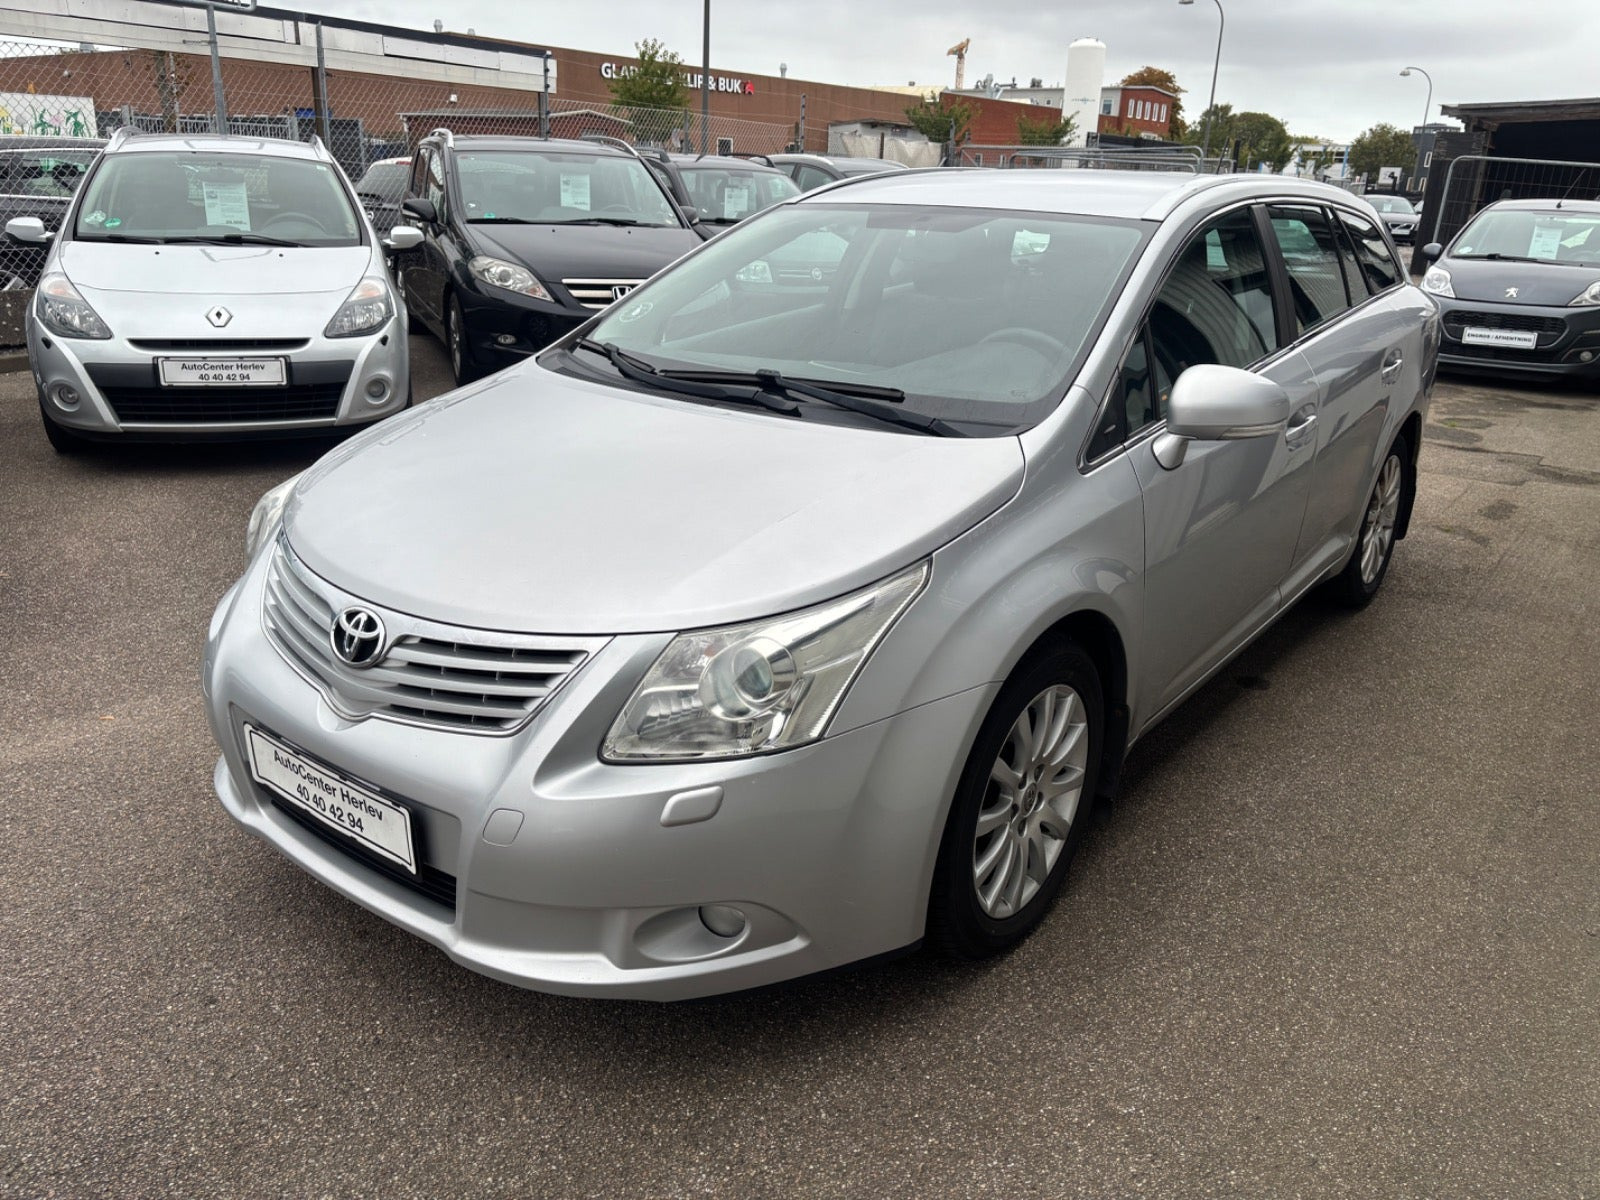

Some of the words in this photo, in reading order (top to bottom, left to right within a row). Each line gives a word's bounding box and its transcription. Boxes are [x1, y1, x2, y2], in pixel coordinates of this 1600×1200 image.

[708, 75, 717, 91] &
[718, 76, 742, 94] BUK
[181, 362, 234, 371] AutoCenter
[236, 362, 265, 371] Herlev
[198, 373, 210, 381] 40
[212, 373, 223, 381] 40
[226, 373, 237, 381] 42
[239, 373, 251, 381] 94
[273, 750, 337, 798] AutoCenter
[339, 787, 383, 821] Herlev
[296, 783, 311, 802] 40
[312, 793, 326, 812] 40
[329, 803, 345, 822] 42
[347, 812, 364, 832] 94
